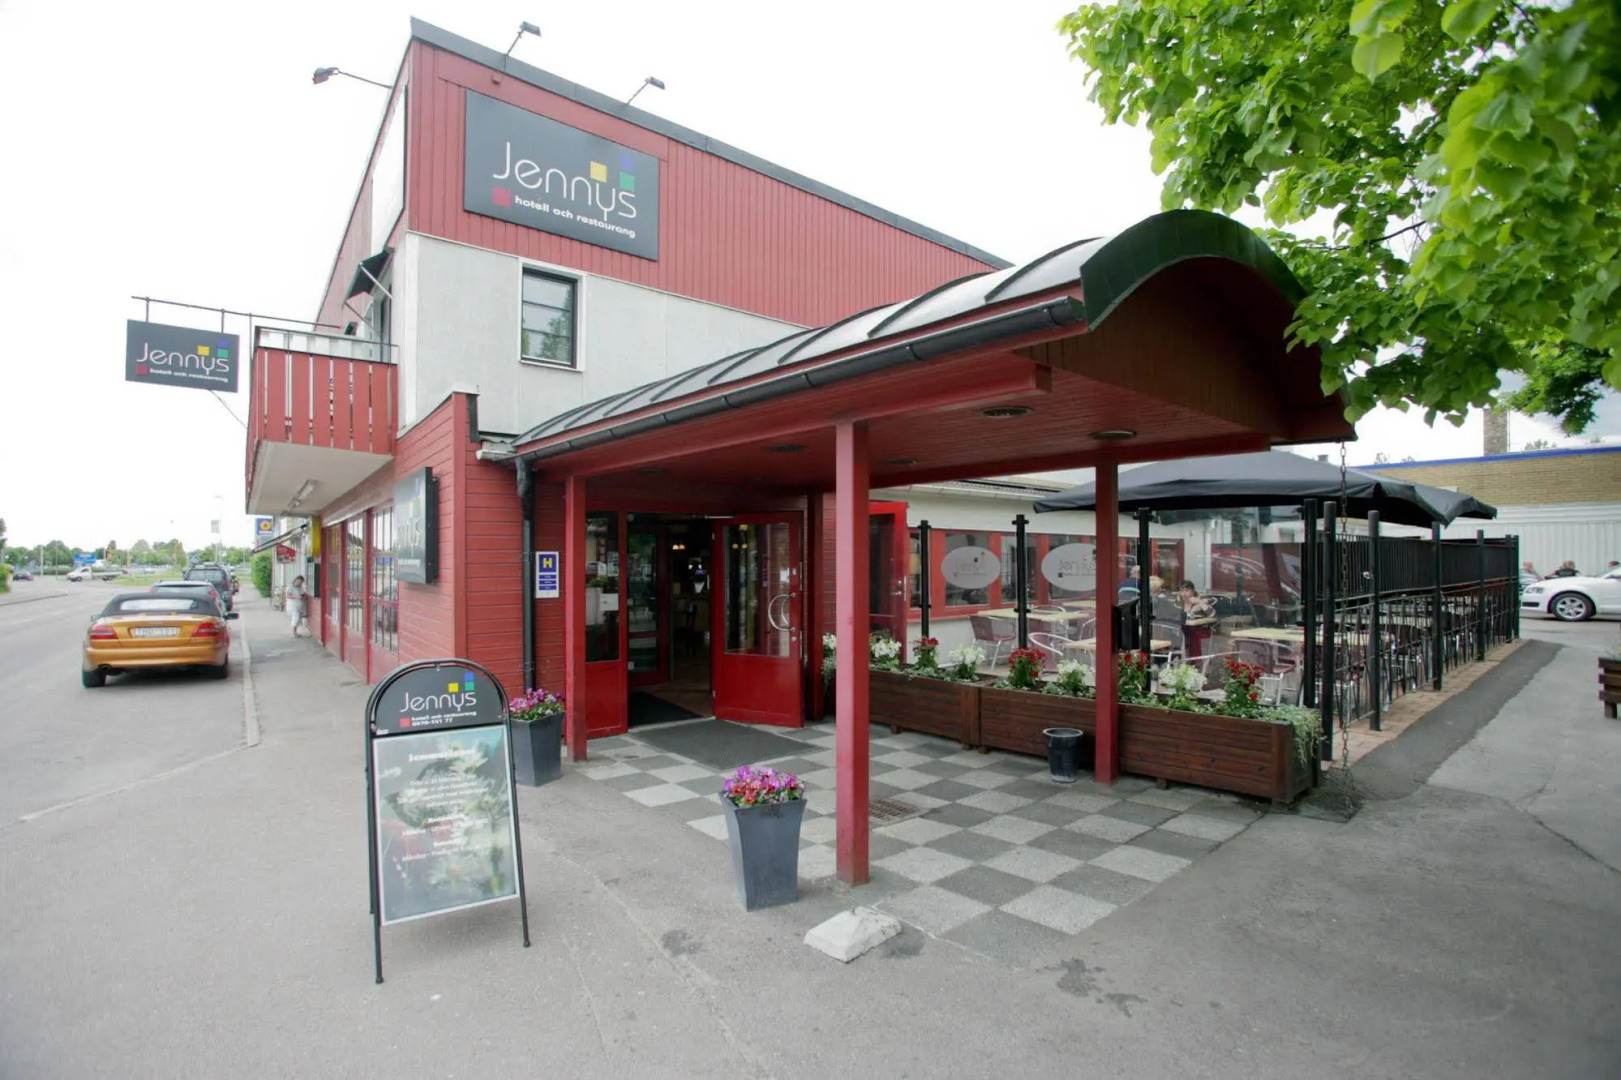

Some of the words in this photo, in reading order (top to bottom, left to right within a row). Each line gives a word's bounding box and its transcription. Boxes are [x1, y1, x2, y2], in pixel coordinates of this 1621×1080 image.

[493, 141, 637, 221] Jennys
[514, 195, 550, 212] hotell
[553, 206, 574, 219] och
[576, 214, 636, 238] restaurang
[136, 342, 230, 376] Jennys
[543, 557, 553, 569] H
[400, 692, 477, 712] Jennys
